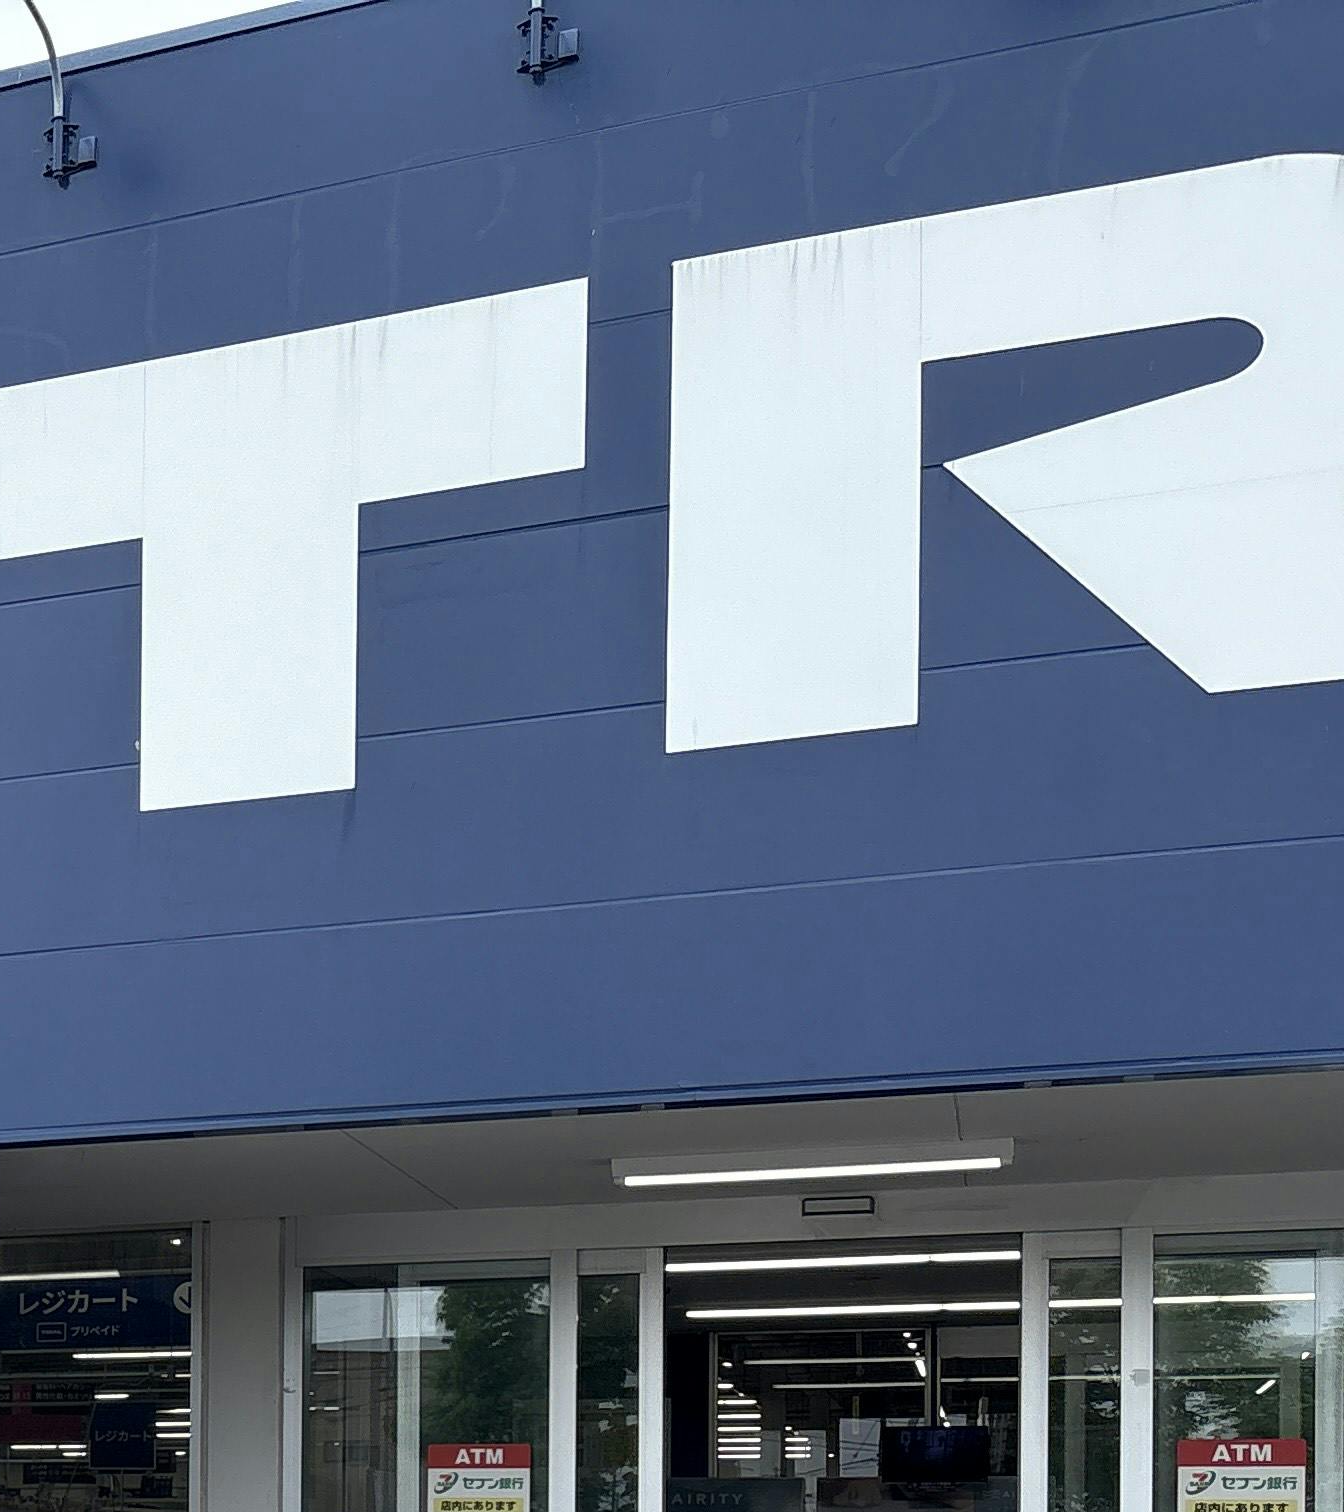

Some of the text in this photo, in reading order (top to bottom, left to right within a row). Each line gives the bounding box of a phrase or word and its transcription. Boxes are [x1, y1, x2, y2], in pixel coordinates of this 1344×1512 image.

[18, 1287, 138, 1315] レジカート
[70, 1325, 120, 1337] プリペイド
[95, 1430, 152, 1442] レジカート
[454, 1448, 504, 1465] ATM
[1212, 1443, 1272, 1462] ATM
[462, 1477, 524, 1490] セブン銀行
[1221, 1476, 1298, 1490] セブン銀行
[440, 1500, 516, 1511] 店内にあります
